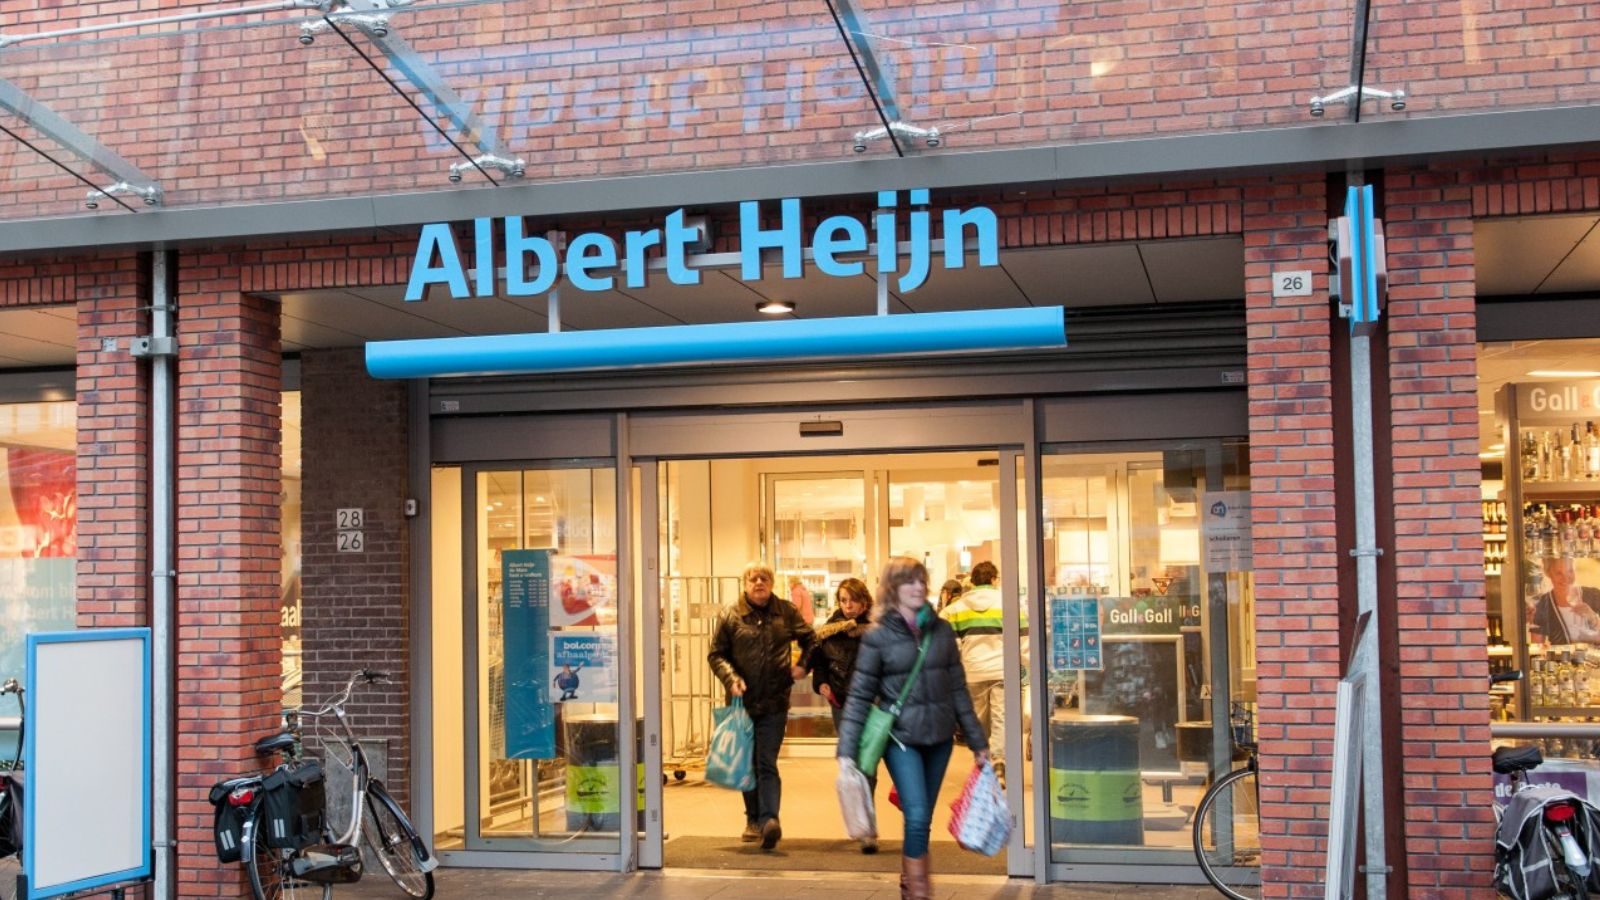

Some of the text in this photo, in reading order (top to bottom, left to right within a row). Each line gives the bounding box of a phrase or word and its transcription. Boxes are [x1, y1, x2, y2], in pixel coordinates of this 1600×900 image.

[404, 188, 1000, 302] Albert Heijn
[1283, 276, 1303, 290] 26
[1530, 386, 1578, 412] Gall
[339, 510, 361, 528] 28
[339, 533, 361, 550] 26
[1110, 608, 1138, 624] Gall
[1144, 607, 1173, 624] Gall
